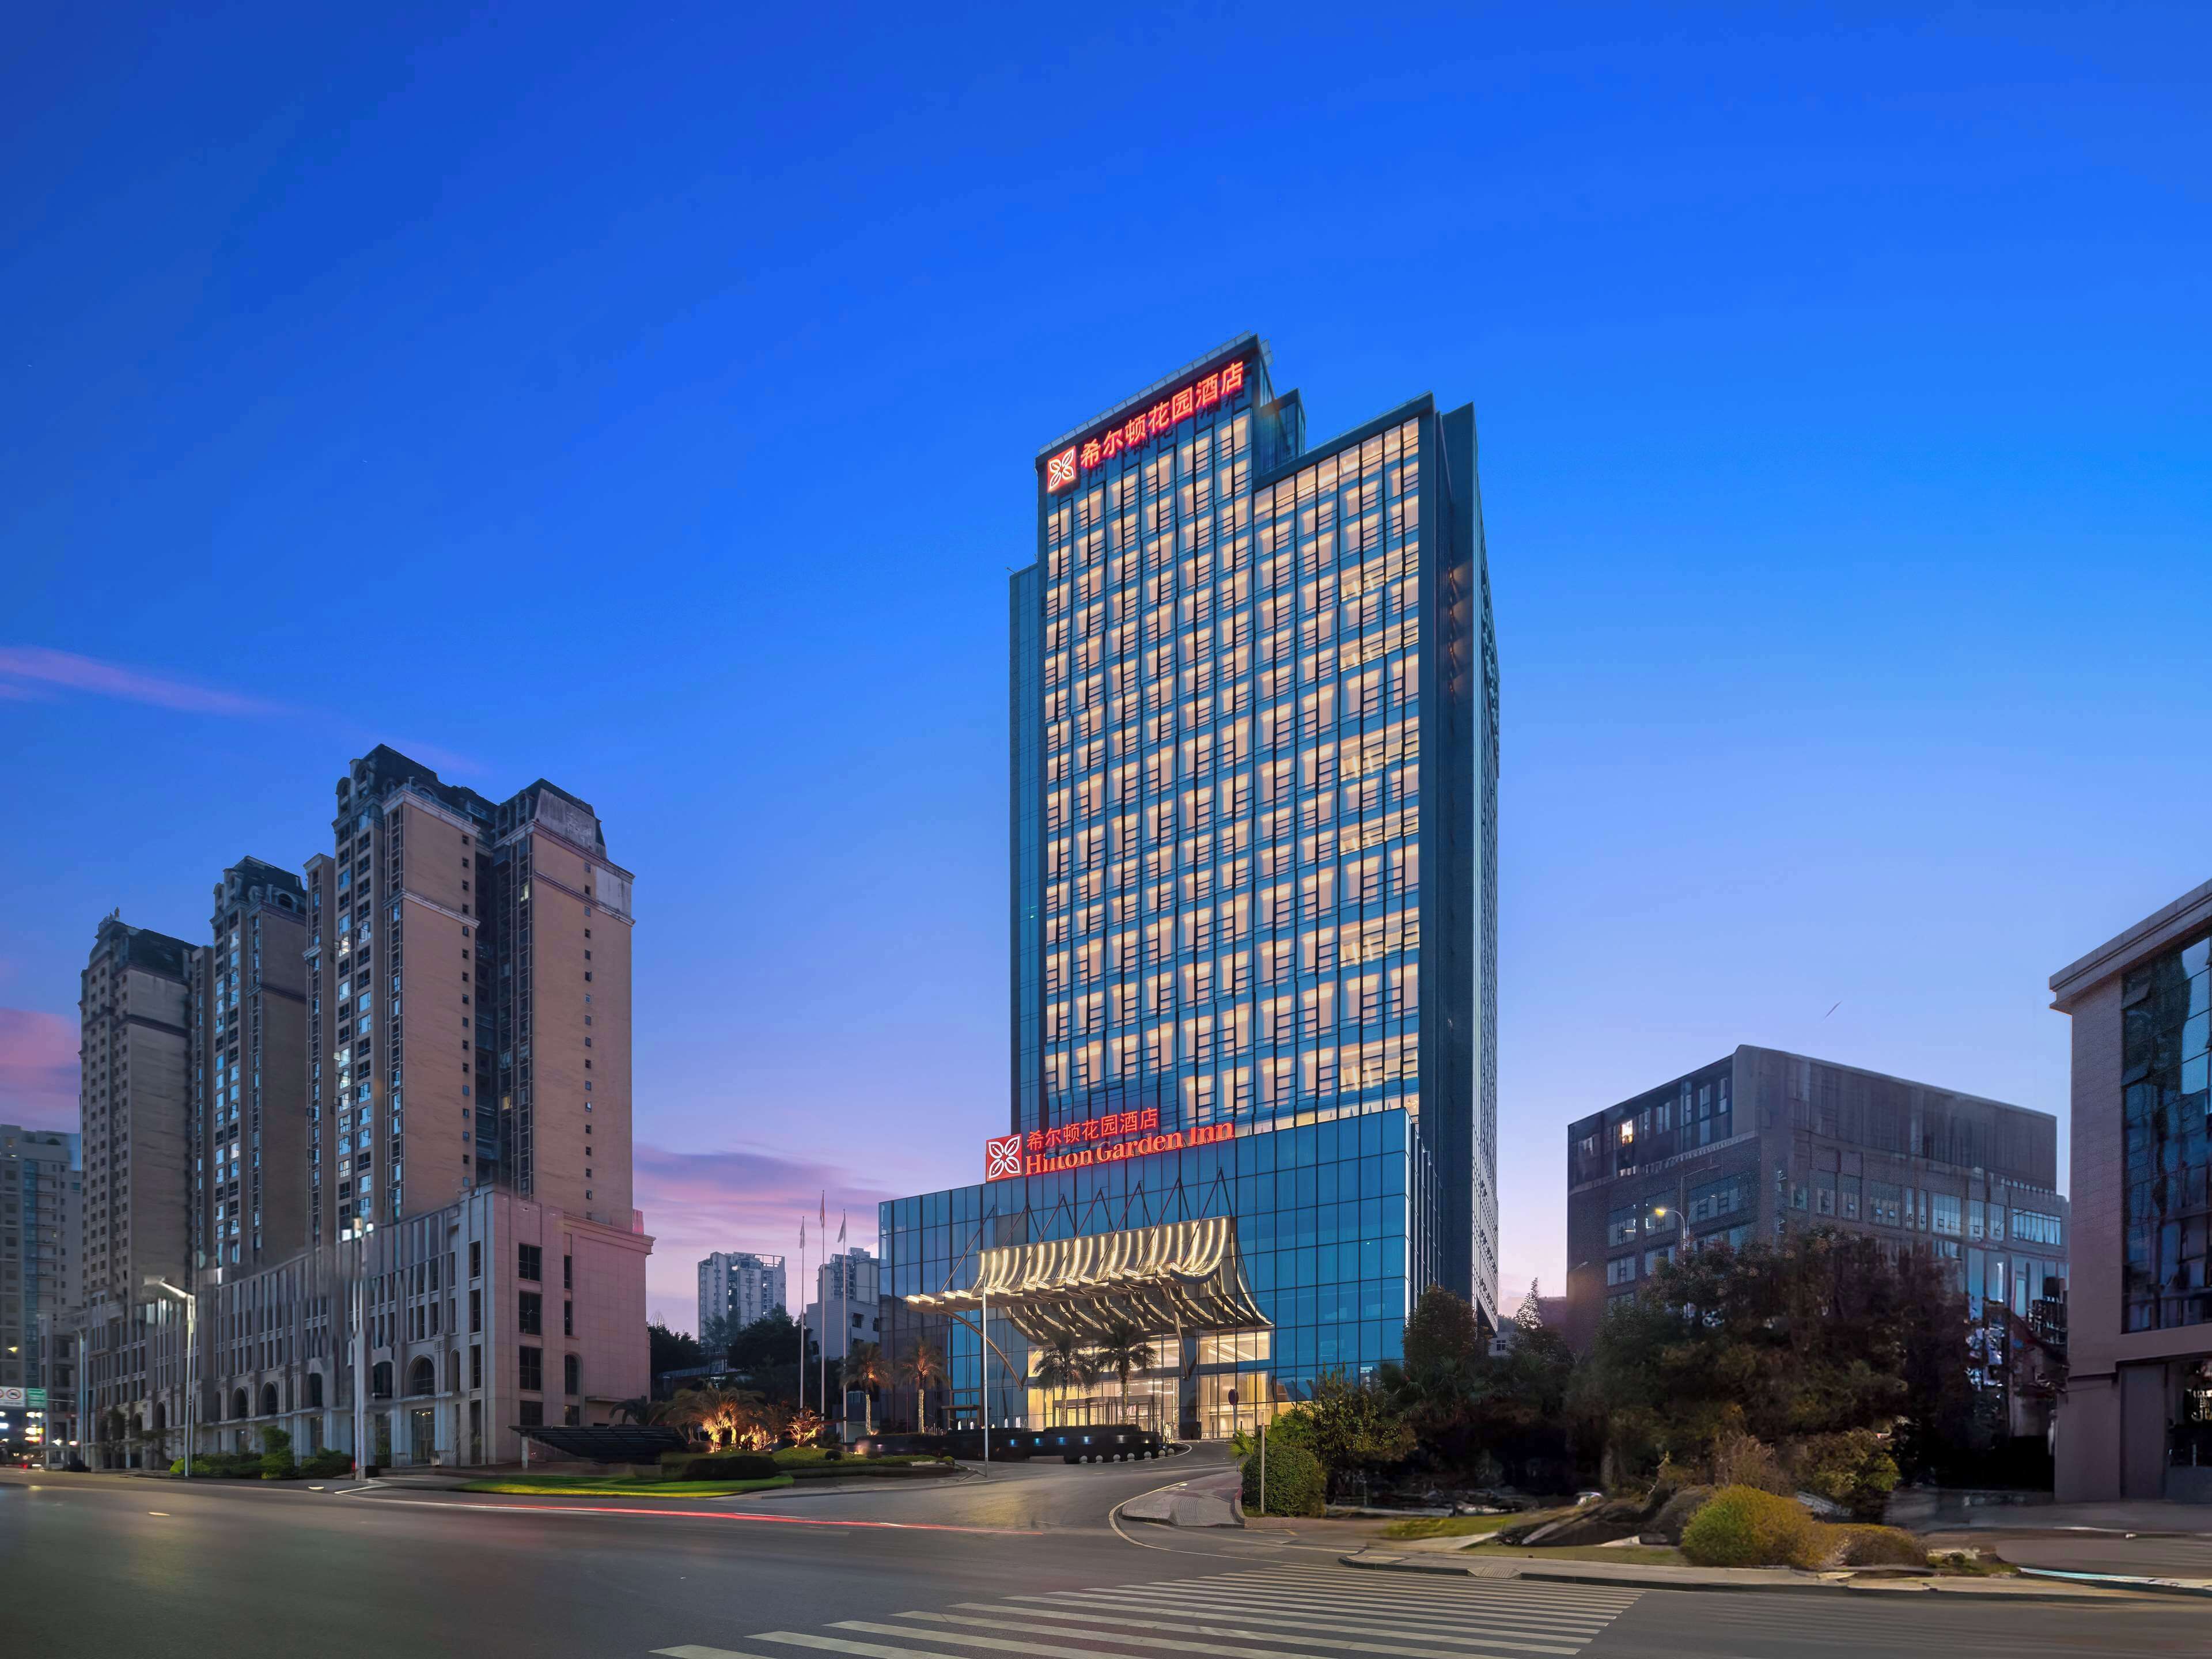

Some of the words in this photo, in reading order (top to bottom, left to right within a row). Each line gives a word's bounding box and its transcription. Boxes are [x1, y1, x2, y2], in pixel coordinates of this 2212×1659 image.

[1080, 361, 1244, 468] 希尔顿花园酒店
[1026, 1107, 1158, 1152] 希尔顿花园酒店
[1096, 1131, 1184, 1162] Garden
[1187, 1122, 1234, 1146] Inn
